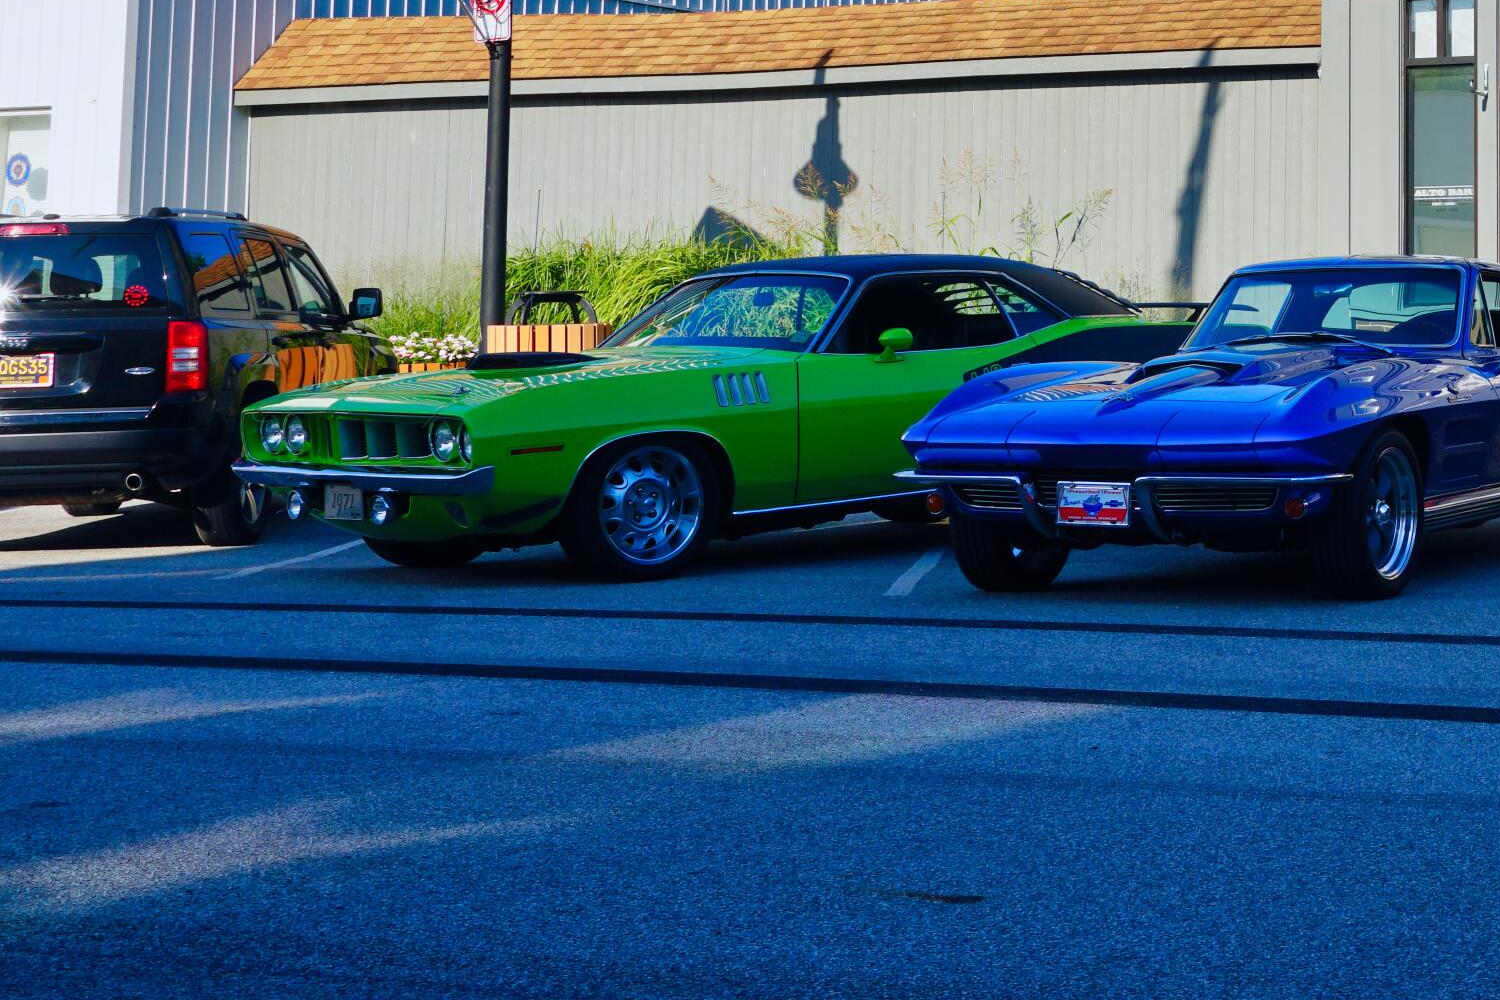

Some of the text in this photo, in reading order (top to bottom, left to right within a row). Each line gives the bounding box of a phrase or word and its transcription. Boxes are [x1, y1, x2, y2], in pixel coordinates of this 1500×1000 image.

[1413, 188, 1474, 197] ALTO BAR
[331, 493, 354, 516] 1971
